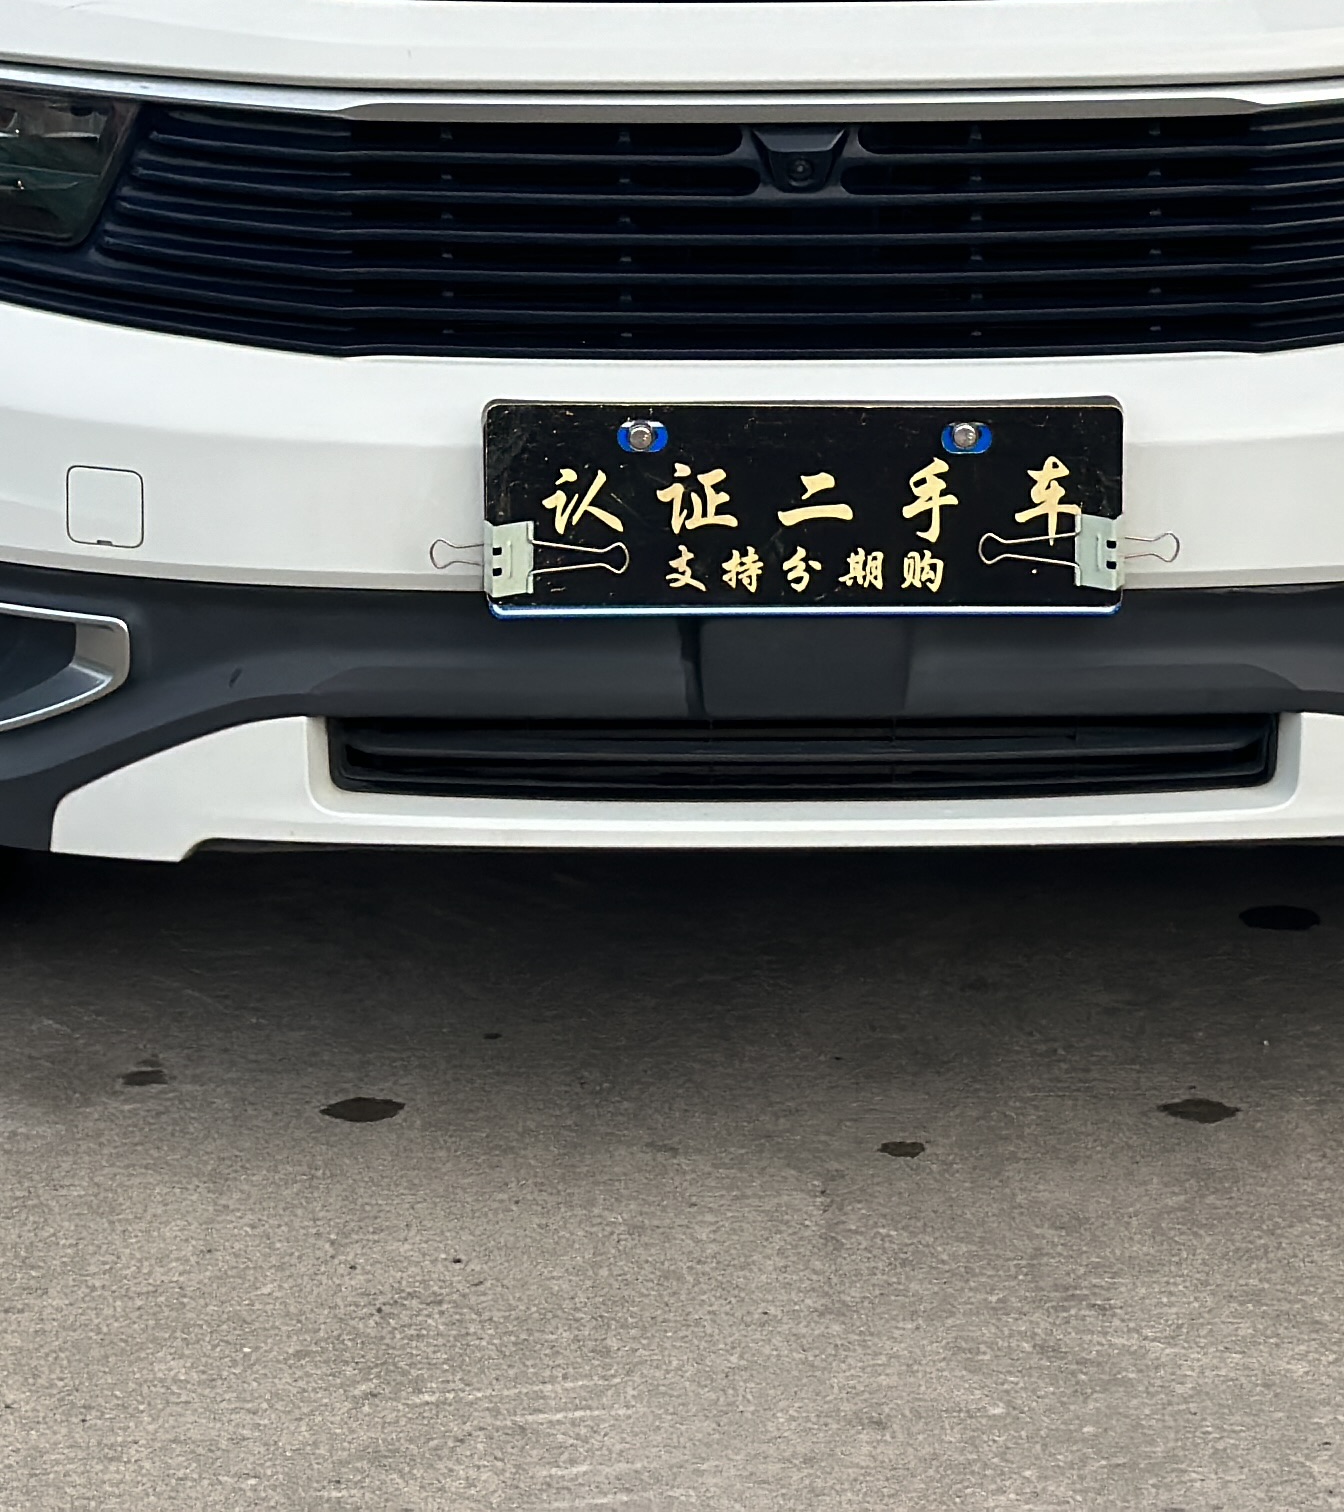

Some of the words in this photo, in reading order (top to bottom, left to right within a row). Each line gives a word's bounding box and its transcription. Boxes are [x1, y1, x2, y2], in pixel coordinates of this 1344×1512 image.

[542, 455, 1081, 545] 认证二手车
[665, 545, 945, 593] 支持分期购
